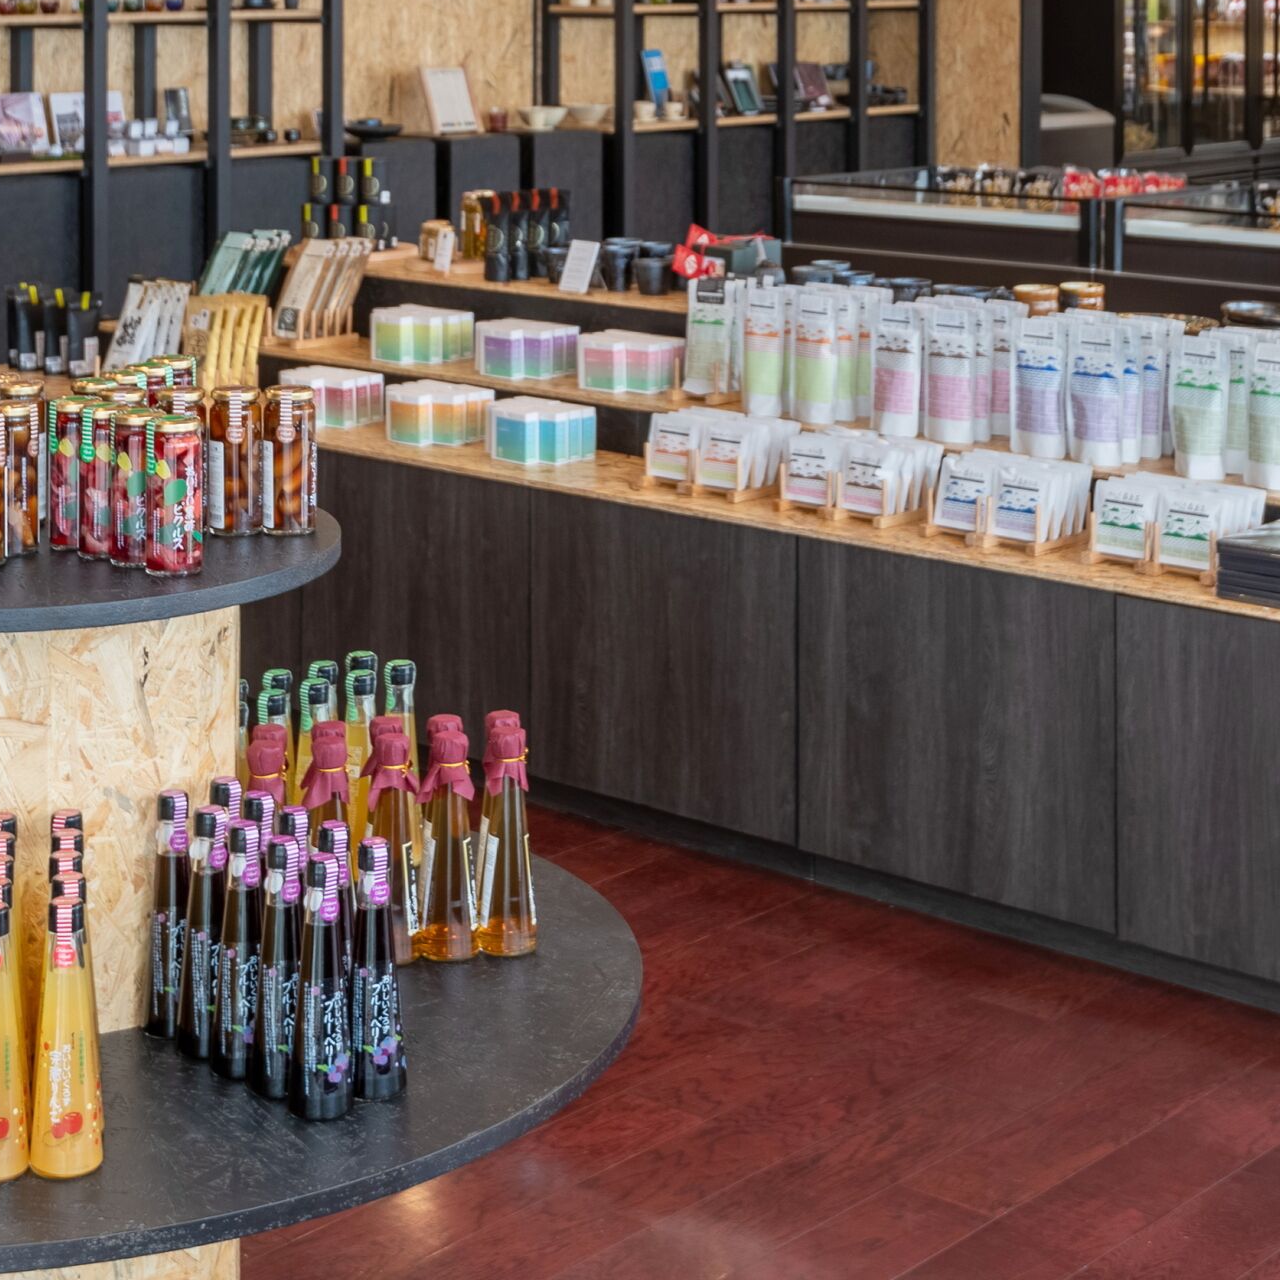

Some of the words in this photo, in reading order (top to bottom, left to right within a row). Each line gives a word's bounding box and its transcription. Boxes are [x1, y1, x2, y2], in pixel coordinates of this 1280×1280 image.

[172, 501, 186, 551] ピクルス
[323, 996, 336, 1068] ブルーベリー
[370, 982, 383, 1051] ブルーベリー
